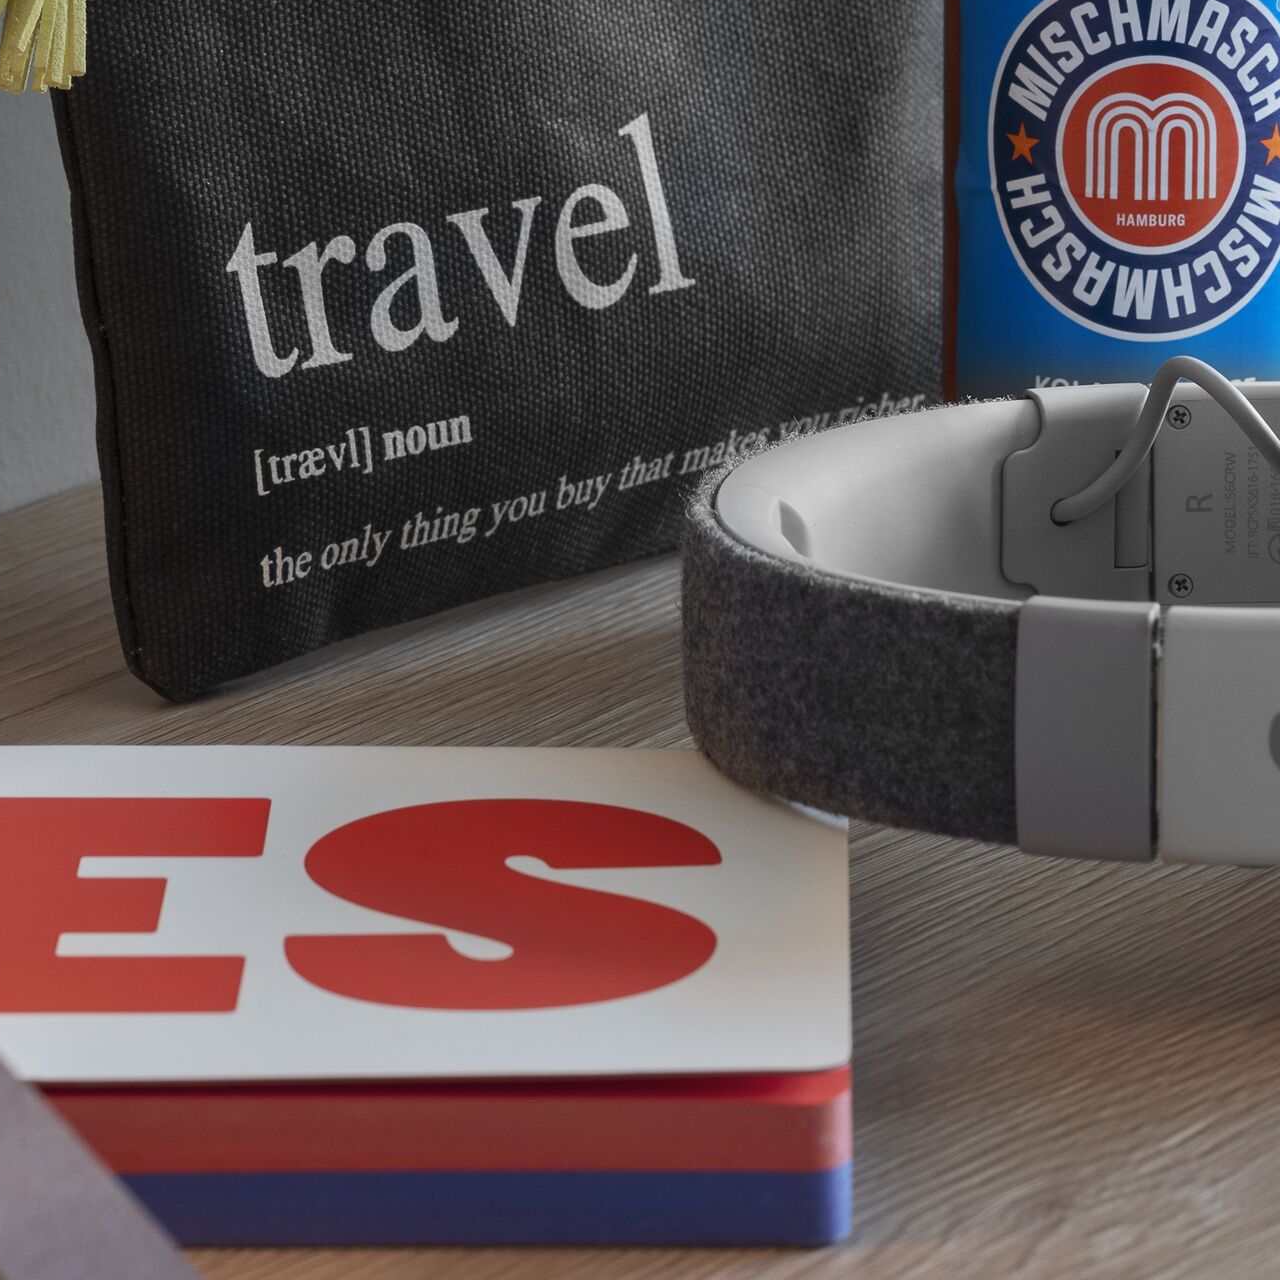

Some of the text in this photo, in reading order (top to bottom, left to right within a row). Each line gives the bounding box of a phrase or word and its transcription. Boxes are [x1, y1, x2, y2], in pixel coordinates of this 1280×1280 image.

[1116, 212, 1186, 228] HAMBURG
[225, 112, 696, 379] travel
[382, 415, 473, 461] noun
[260, 546, 313, 588] the
[321, 524, 392, 568] only
[400, 506, 481, 550] thing
[485, 490, 547, 537] you
[556, 474, 613, 511] buy
[619, 451, 675, 491] that
[1185, 493, 1213, 513] R
